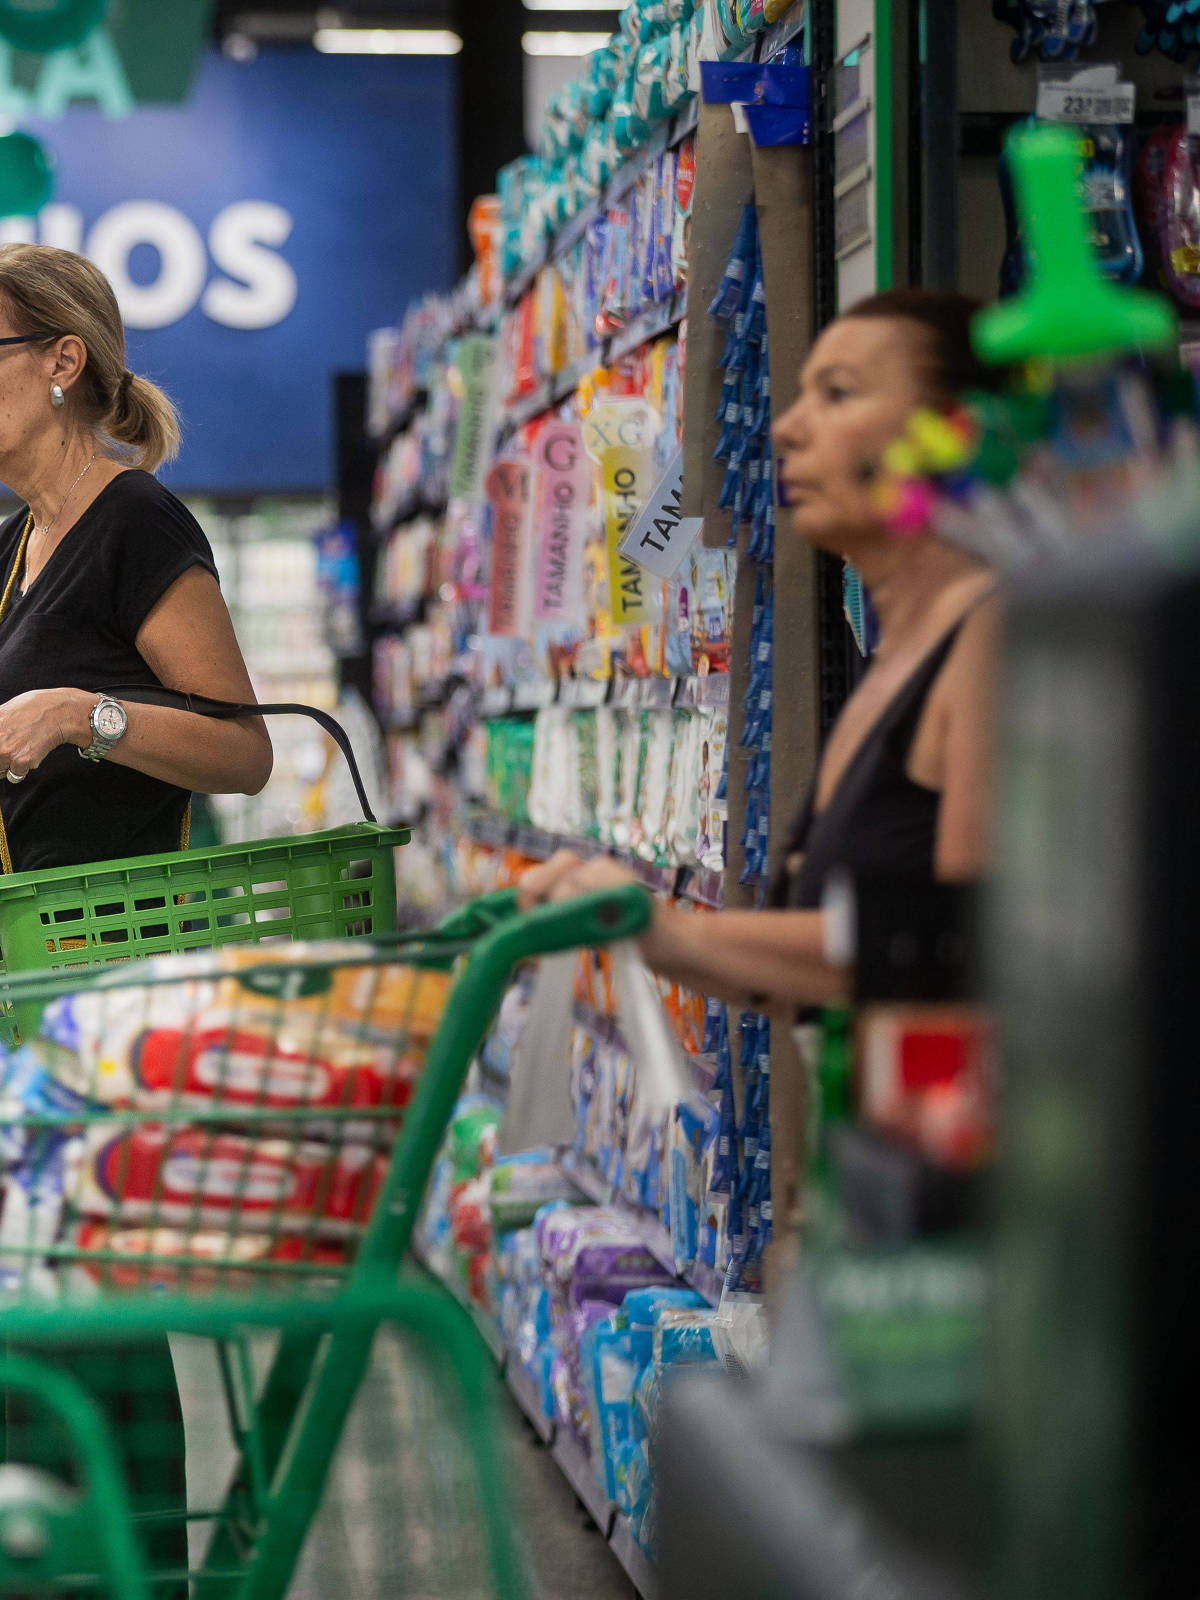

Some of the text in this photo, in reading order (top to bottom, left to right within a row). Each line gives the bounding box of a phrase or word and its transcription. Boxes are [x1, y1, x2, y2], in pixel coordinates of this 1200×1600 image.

[589, 417, 643, 448] XG
[543, 481, 575, 612] TAMANHO
[613, 467, 643, 614] TAMNHO
[639, 474, 684, 553] TAM
